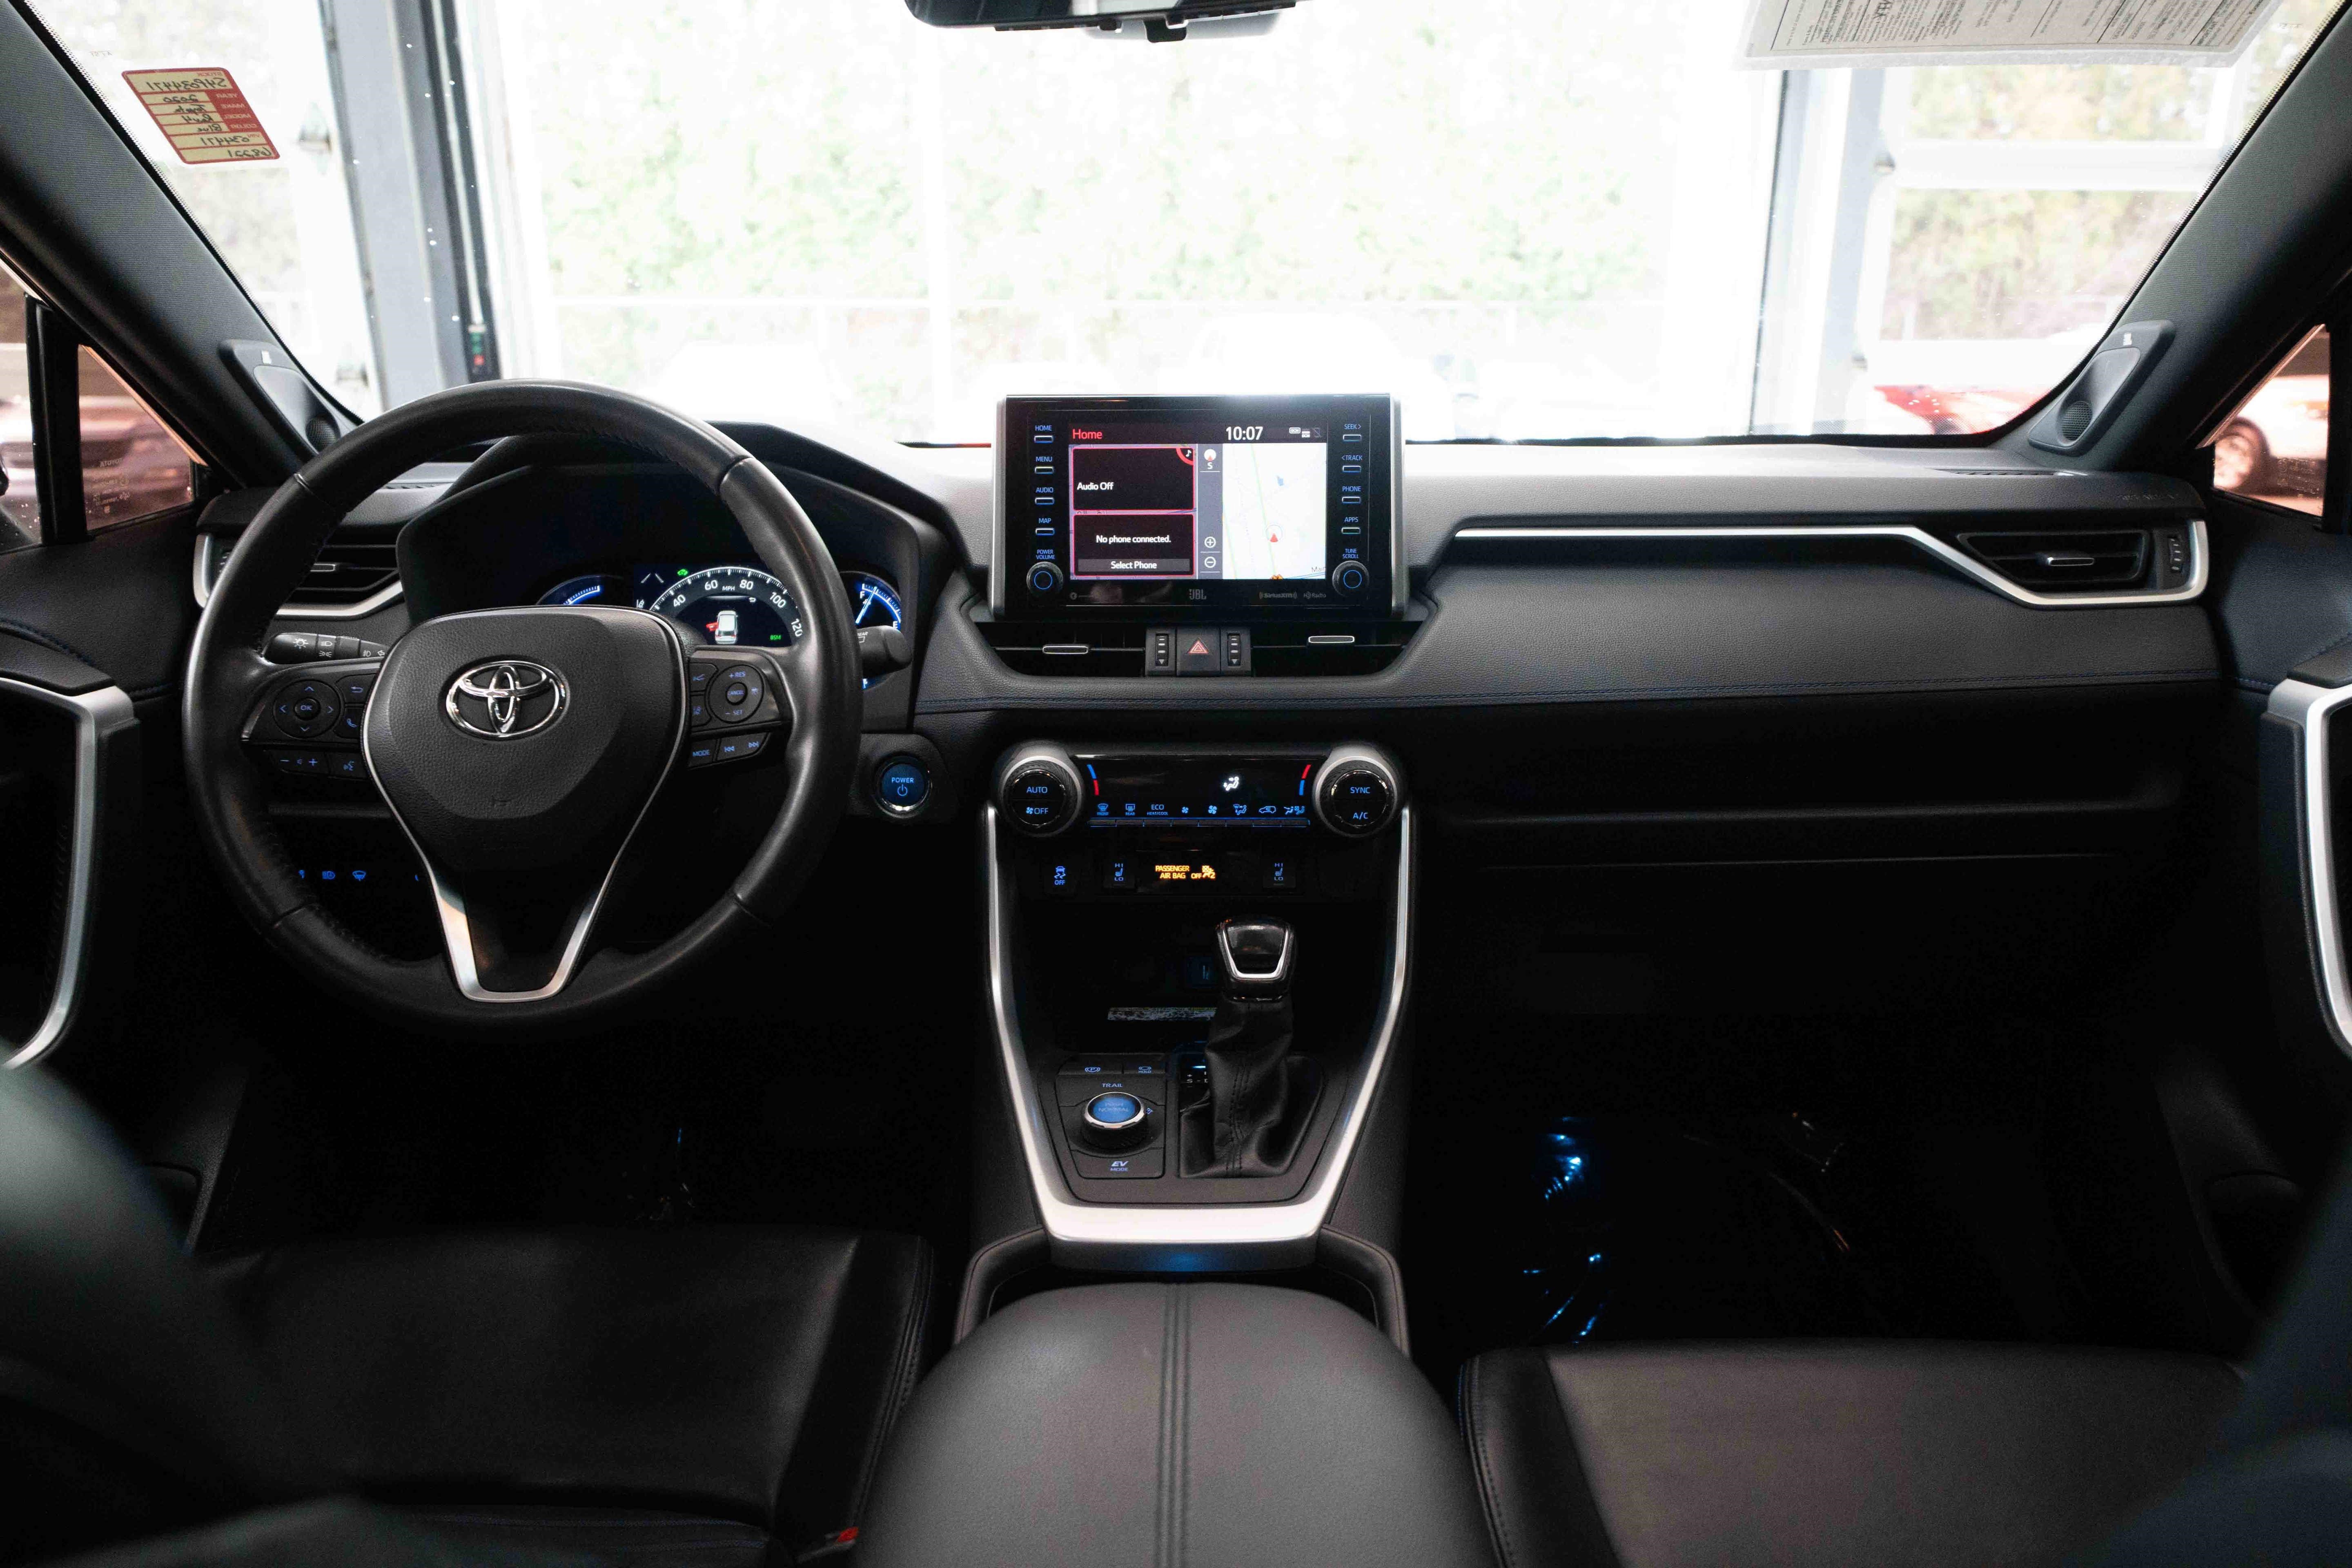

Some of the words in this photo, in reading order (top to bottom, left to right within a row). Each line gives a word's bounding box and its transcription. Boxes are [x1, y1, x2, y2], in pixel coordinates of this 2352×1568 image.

[1072, 429, 1102, 439] Home
[1225, 426, 1263, 441] 10:07
[1077, 482, 1098, 490] Audio
[1100, 482, 1114, 490] Off
[1109, 535, 1131, 544] phone
[1111, 561, 1133, 569] Select
[1134, 561, 1157, 569] Phone
[704, 580, 718, 590] 60
[739, 579, 753, 590] 80
[769, 592, 787, 608] 100
[1189, 589, 1207, 600] JBL
[673, 594, 686, 608] 40
[790, 618, 803, 637] 120
